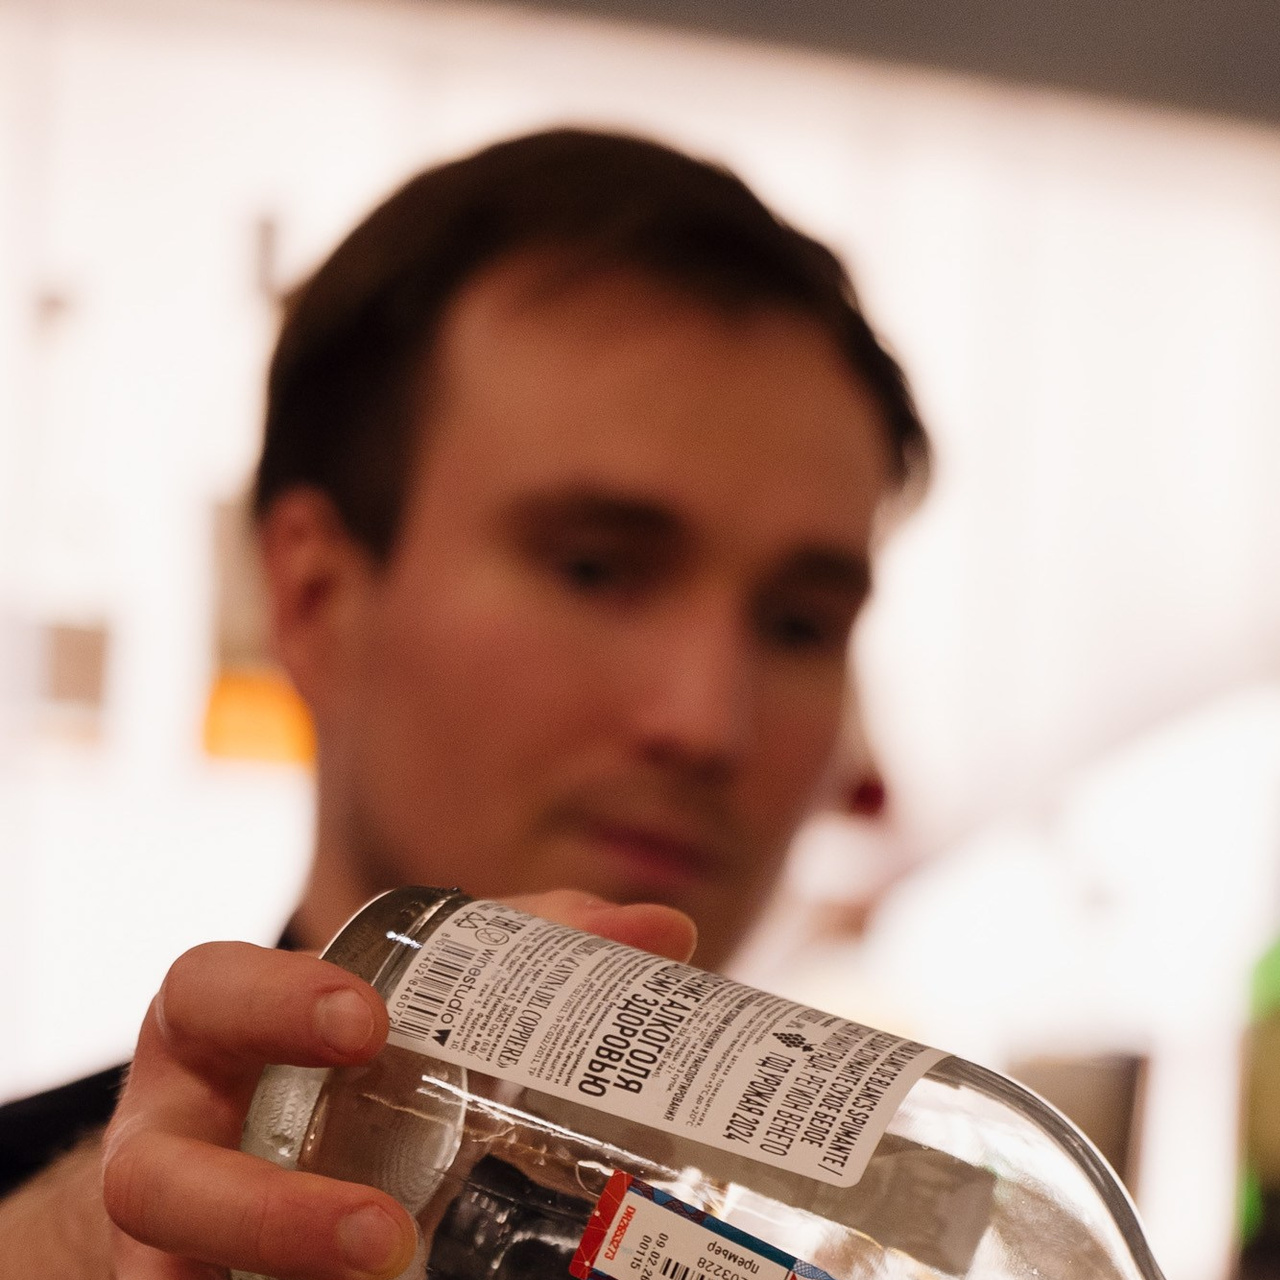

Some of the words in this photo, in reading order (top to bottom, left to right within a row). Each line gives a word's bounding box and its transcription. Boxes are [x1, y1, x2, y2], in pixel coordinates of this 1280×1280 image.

[437, 945, 501, 1028] winestudio
[537, 953, 583, 995] «CANTINA
[525, 989, 555, 1012] DEL
[482, 1004, 519, 1063] осуществления
[493, 1007, 543, 1072] COPPIERE»
[571, 990, 661, 1100] ЗДОРОВЬЮ
[611, 996, 693, 1095] АЛКОГОЛЯ
[560, 1045, 587, 1087] кормящим
[755, 1049, 796, 1075] ГОД
[834, 1047, 880, 1086] СПУМАНТЕ
[871, 1067, 898, 1081] DE
[662, 1052, 708, 1122] ТРАНСПОРТИРОВАНИЯ
[735, 1067, 785, 1116] УРОЖАЯ
[780, 1070, 827, 1113] РЕГИОН
[817, 1081, 854, 1114] СУХОЕ
[850, 1076, 891, 1112] BLANCS
[721, 1111, 761, 1145] 2024
[757, 1108, 806, 1158] ВЕНЕТО
[799, 1110, 837, 1148] БЕЛОЕ
[821, 1108, 871, 1167] SPUMANTE
[628, 1233, 653, 1271] 00115
[703, 1238, 762, 1275] премьер
